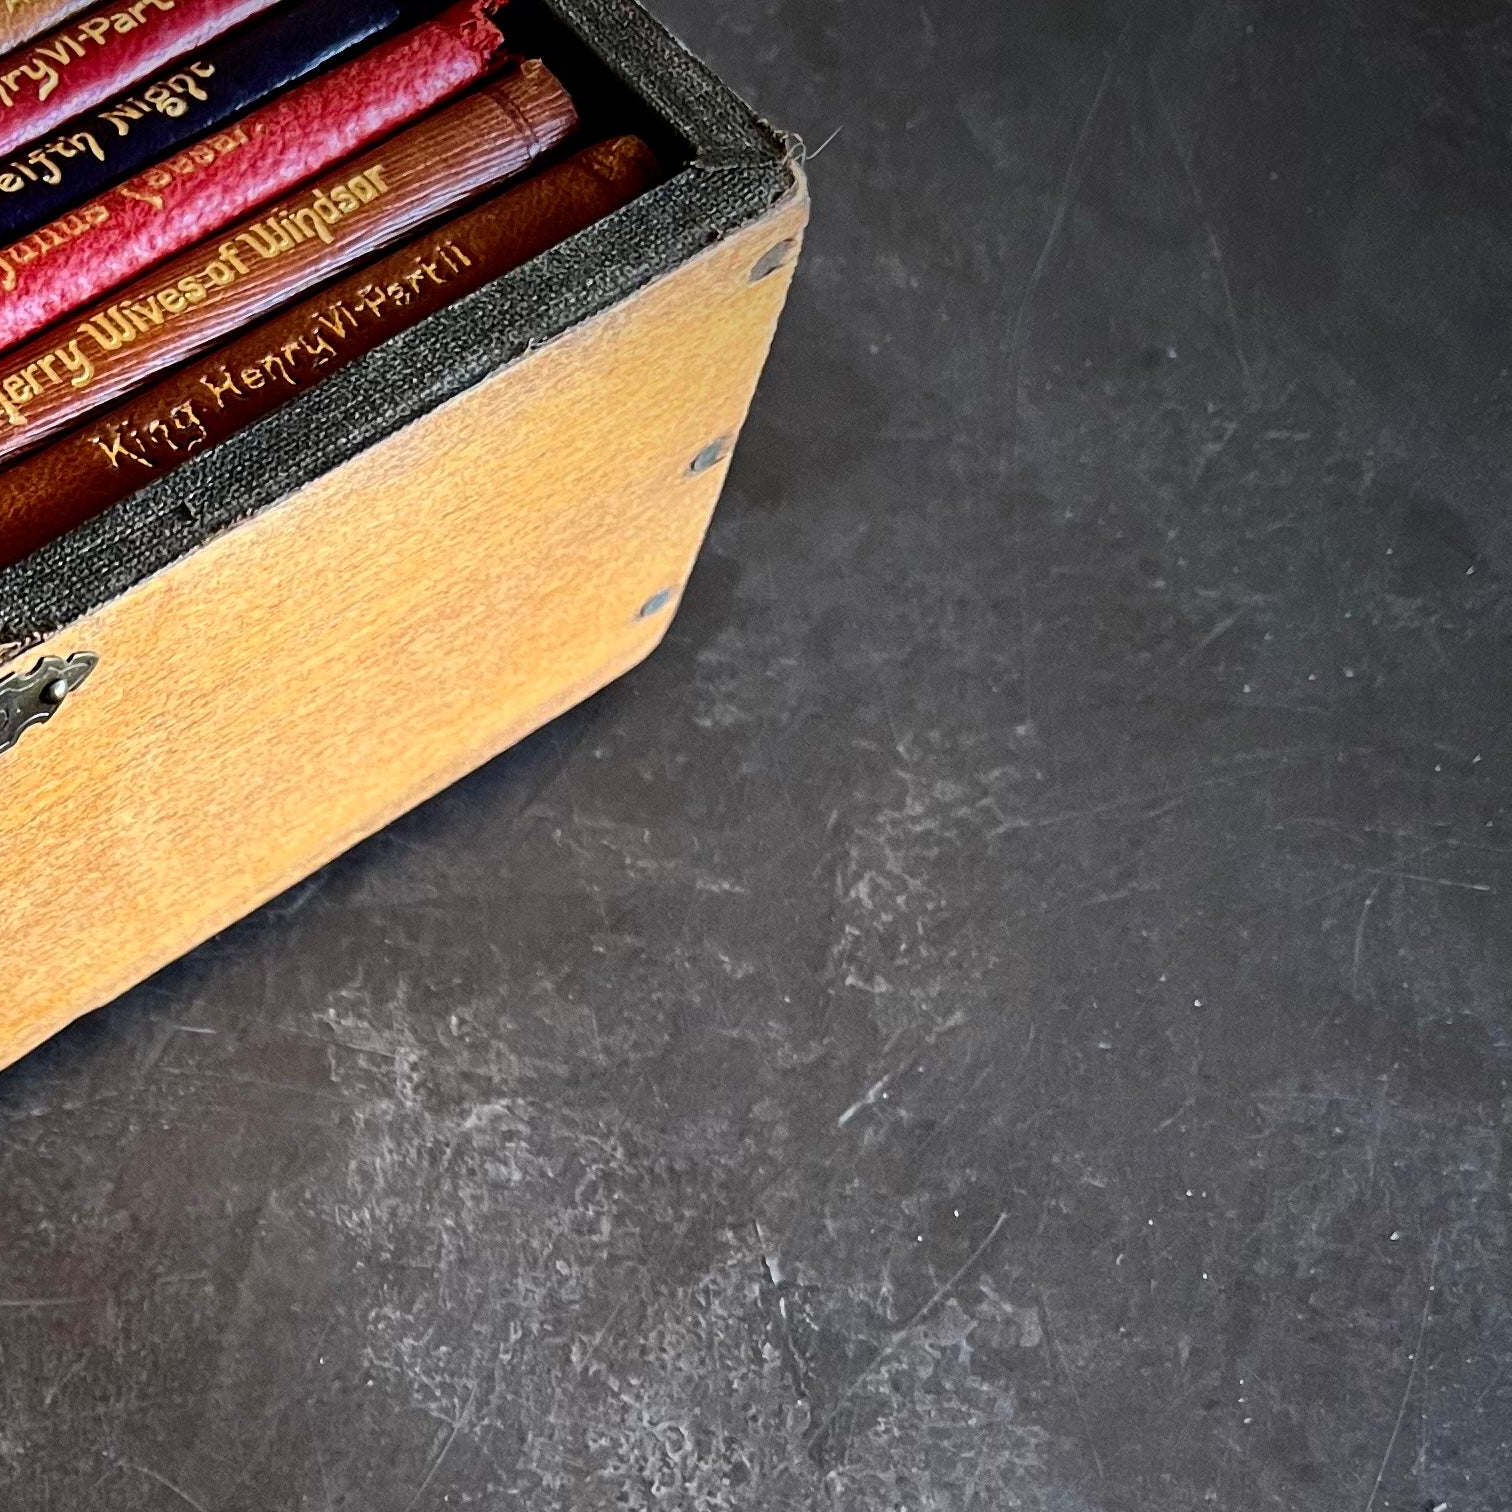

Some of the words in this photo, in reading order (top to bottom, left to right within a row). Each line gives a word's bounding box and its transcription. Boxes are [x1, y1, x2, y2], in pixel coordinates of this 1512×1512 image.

[77, 275, 207, 351] Wives
[235, 164, 389, 259] Windsor
[89, 401, 207, 468] King
[201, 327, 337, 408] Henry
